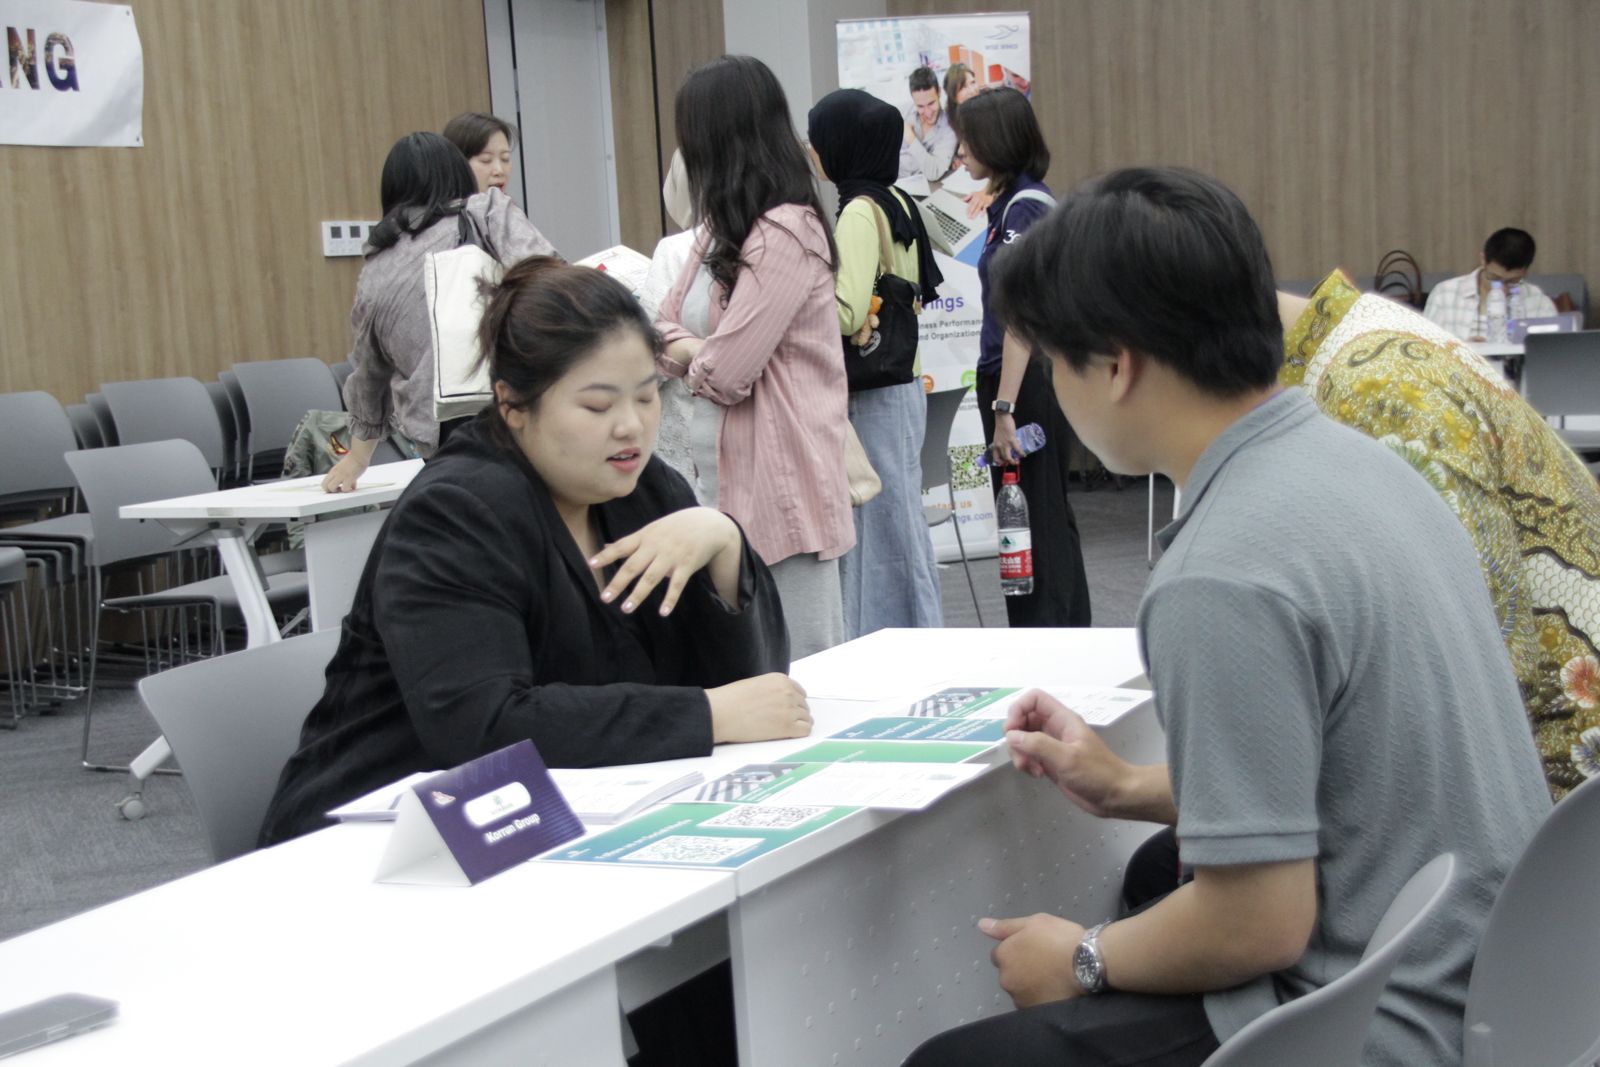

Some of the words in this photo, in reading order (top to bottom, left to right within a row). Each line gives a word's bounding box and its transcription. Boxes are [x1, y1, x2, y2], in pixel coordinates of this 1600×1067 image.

[0, 26, 80, 92] NG
[923, 297, 964, 313] ings
[513, 813, 541, 830] Group
